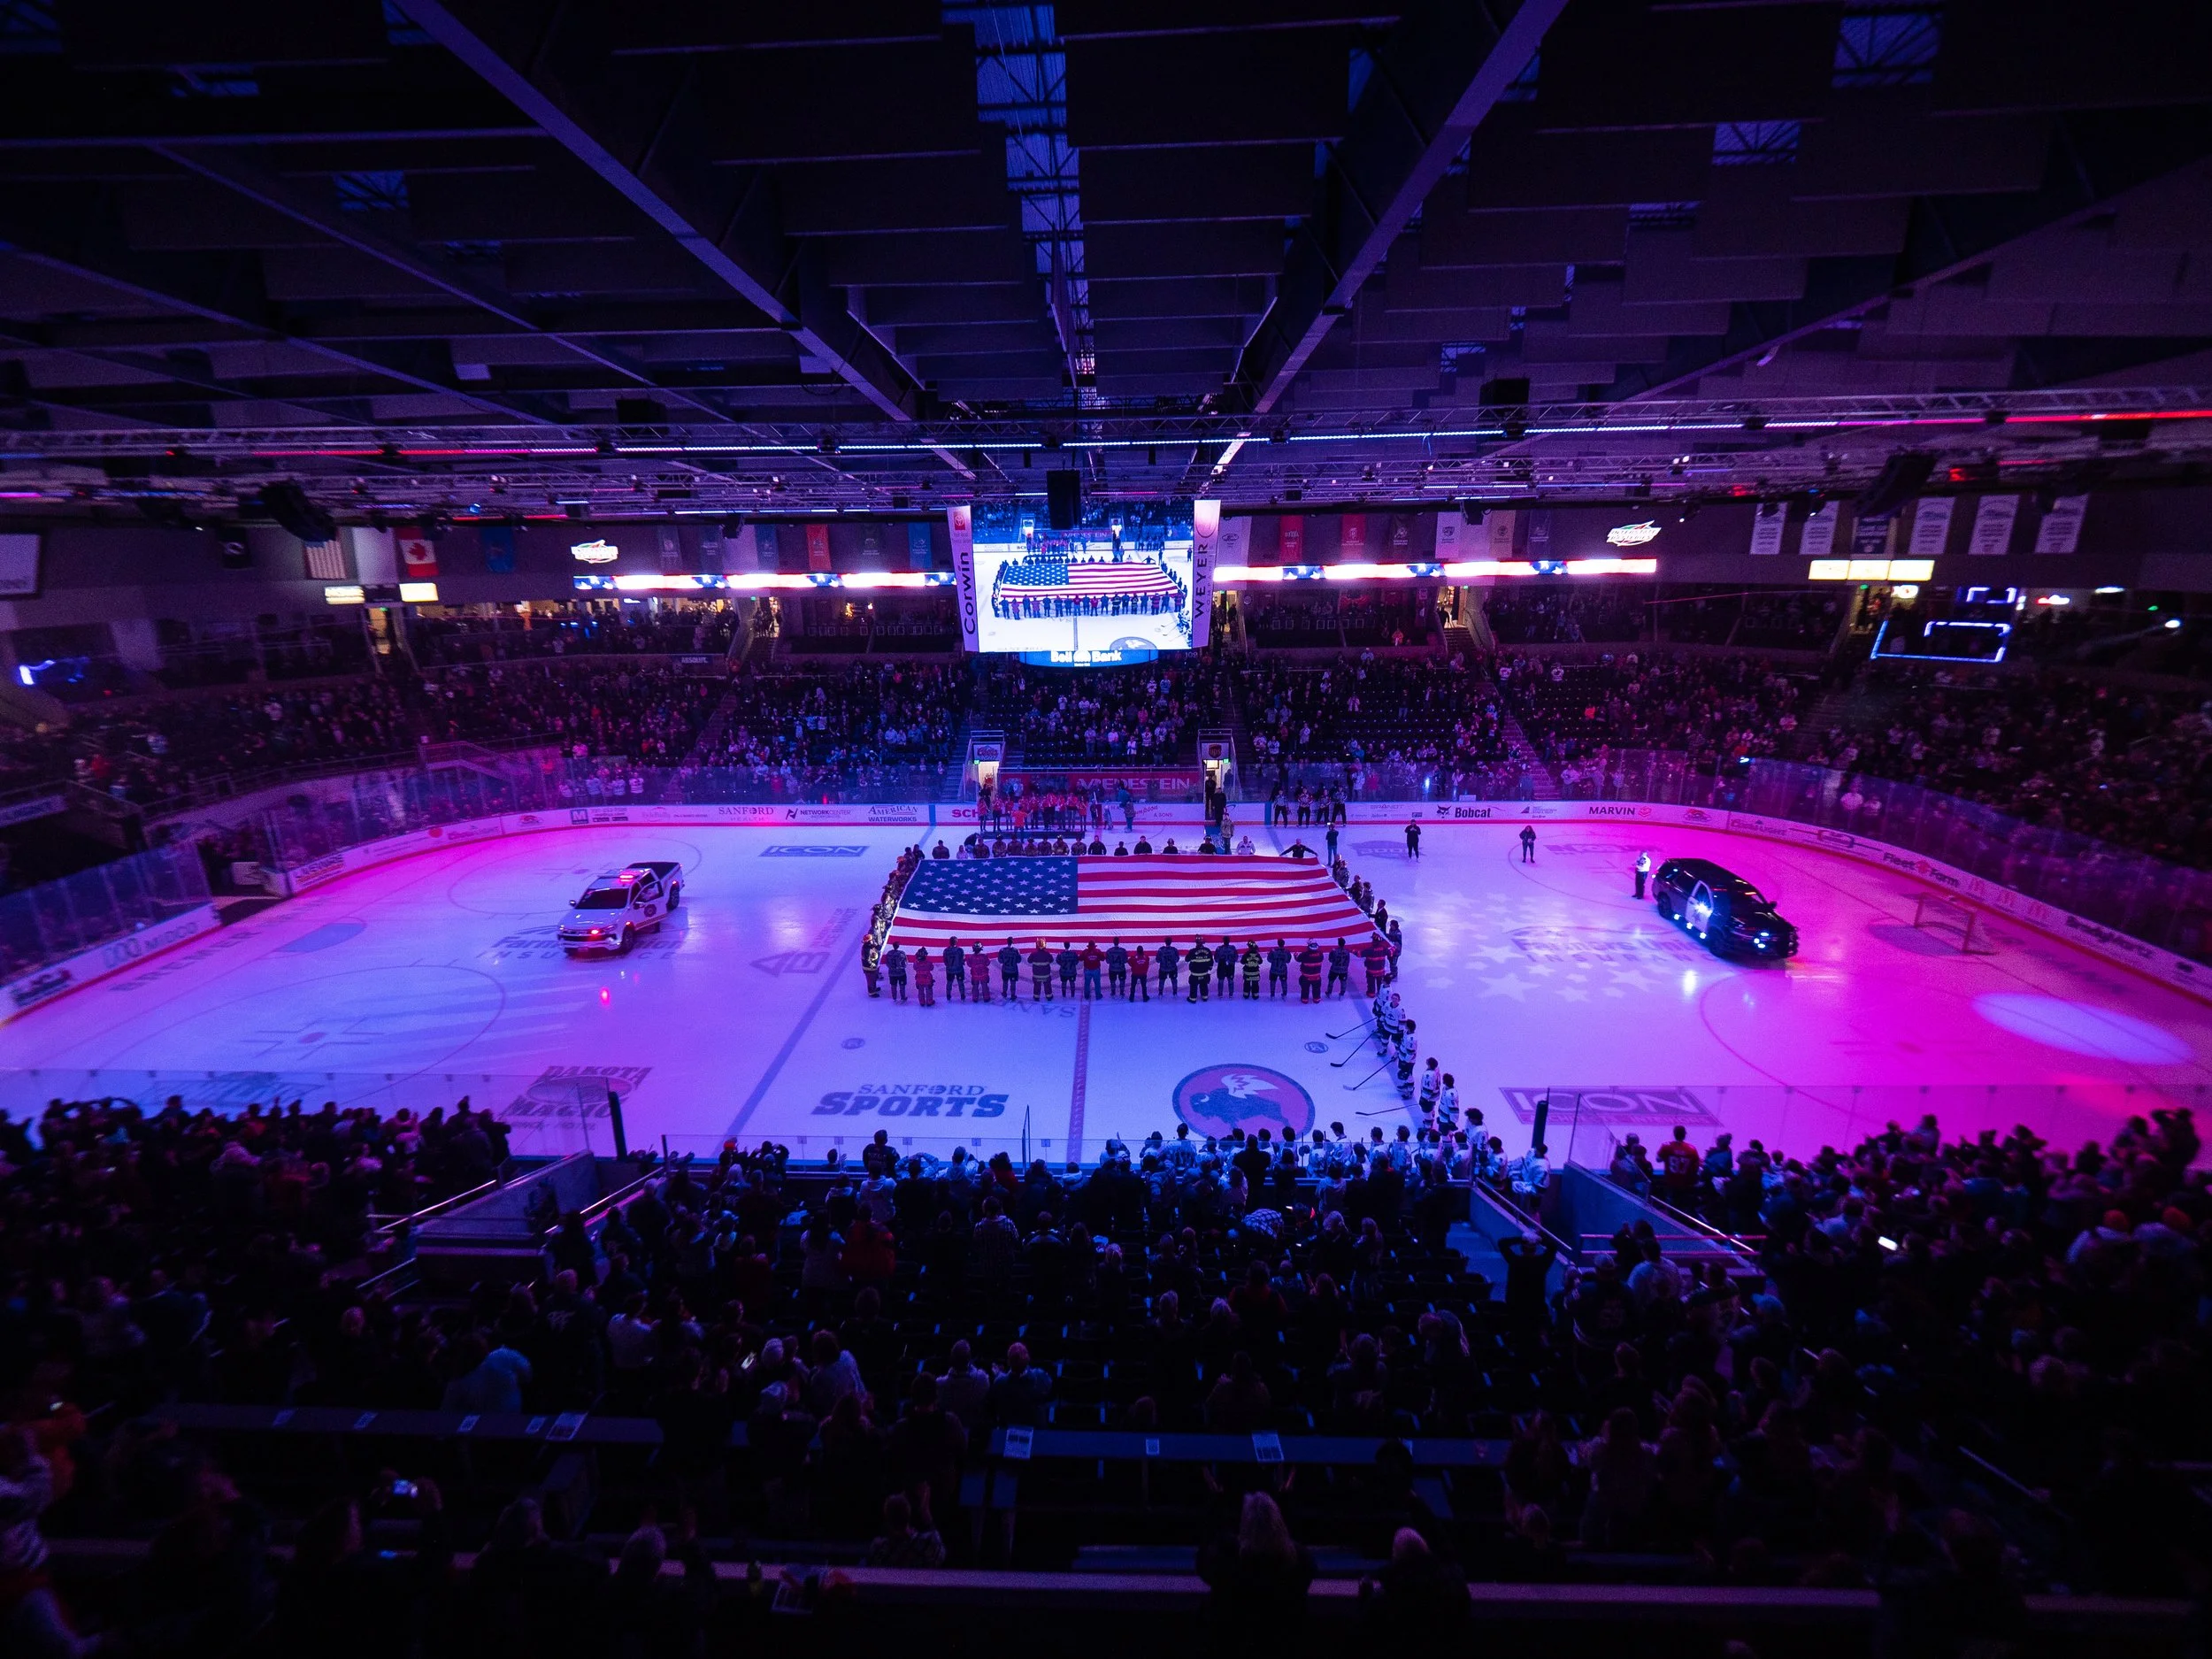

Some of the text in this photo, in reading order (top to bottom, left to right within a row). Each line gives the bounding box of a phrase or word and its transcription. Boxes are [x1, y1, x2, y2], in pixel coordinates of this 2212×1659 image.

[1194, 543, 1208, 619] WEYER
[959, 552, 976, 635] Corwin
[718, 806, 774, 815] SANFORD
[868, 805, 918, 816] AMERICAN
[1454, 807, 1492, 818] Bobcat
[1588, 806, 1636, 815] MARVIN
[530, 1065, 653, 1089] DAKOTA
[858, 1084, 986, 1095] SANFORD
[810, 1091, 1010, 1118] SPORTS
[1510, 1093, 1701, 1114] ICON
